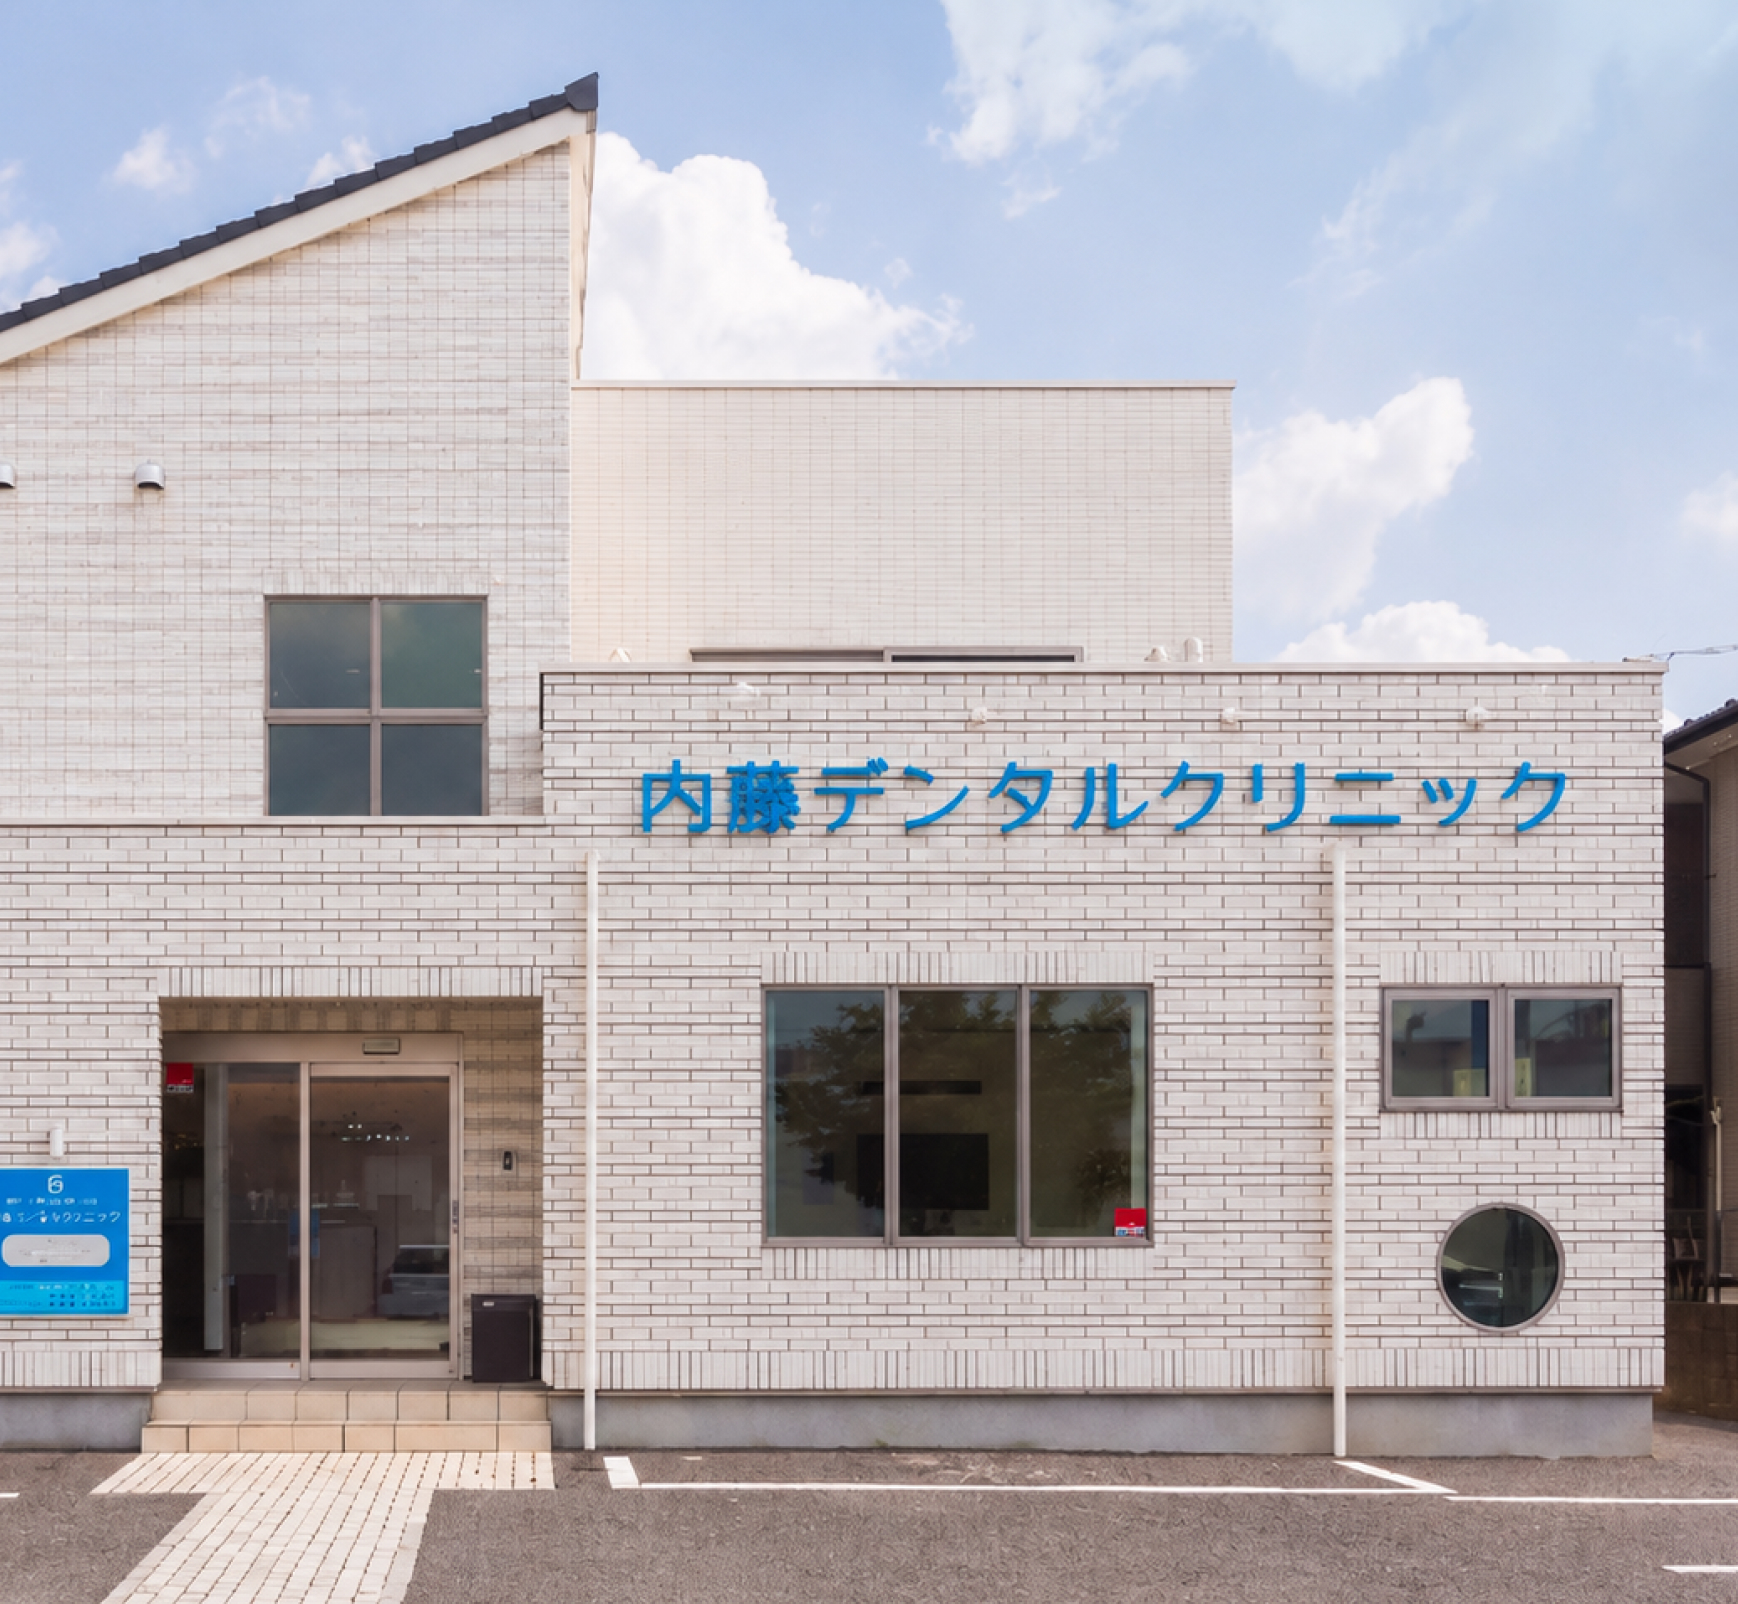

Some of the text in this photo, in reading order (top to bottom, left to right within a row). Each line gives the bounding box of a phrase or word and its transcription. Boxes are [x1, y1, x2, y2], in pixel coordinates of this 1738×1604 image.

[642, 757, 1567, 833] 内藤デンタルクリニック
